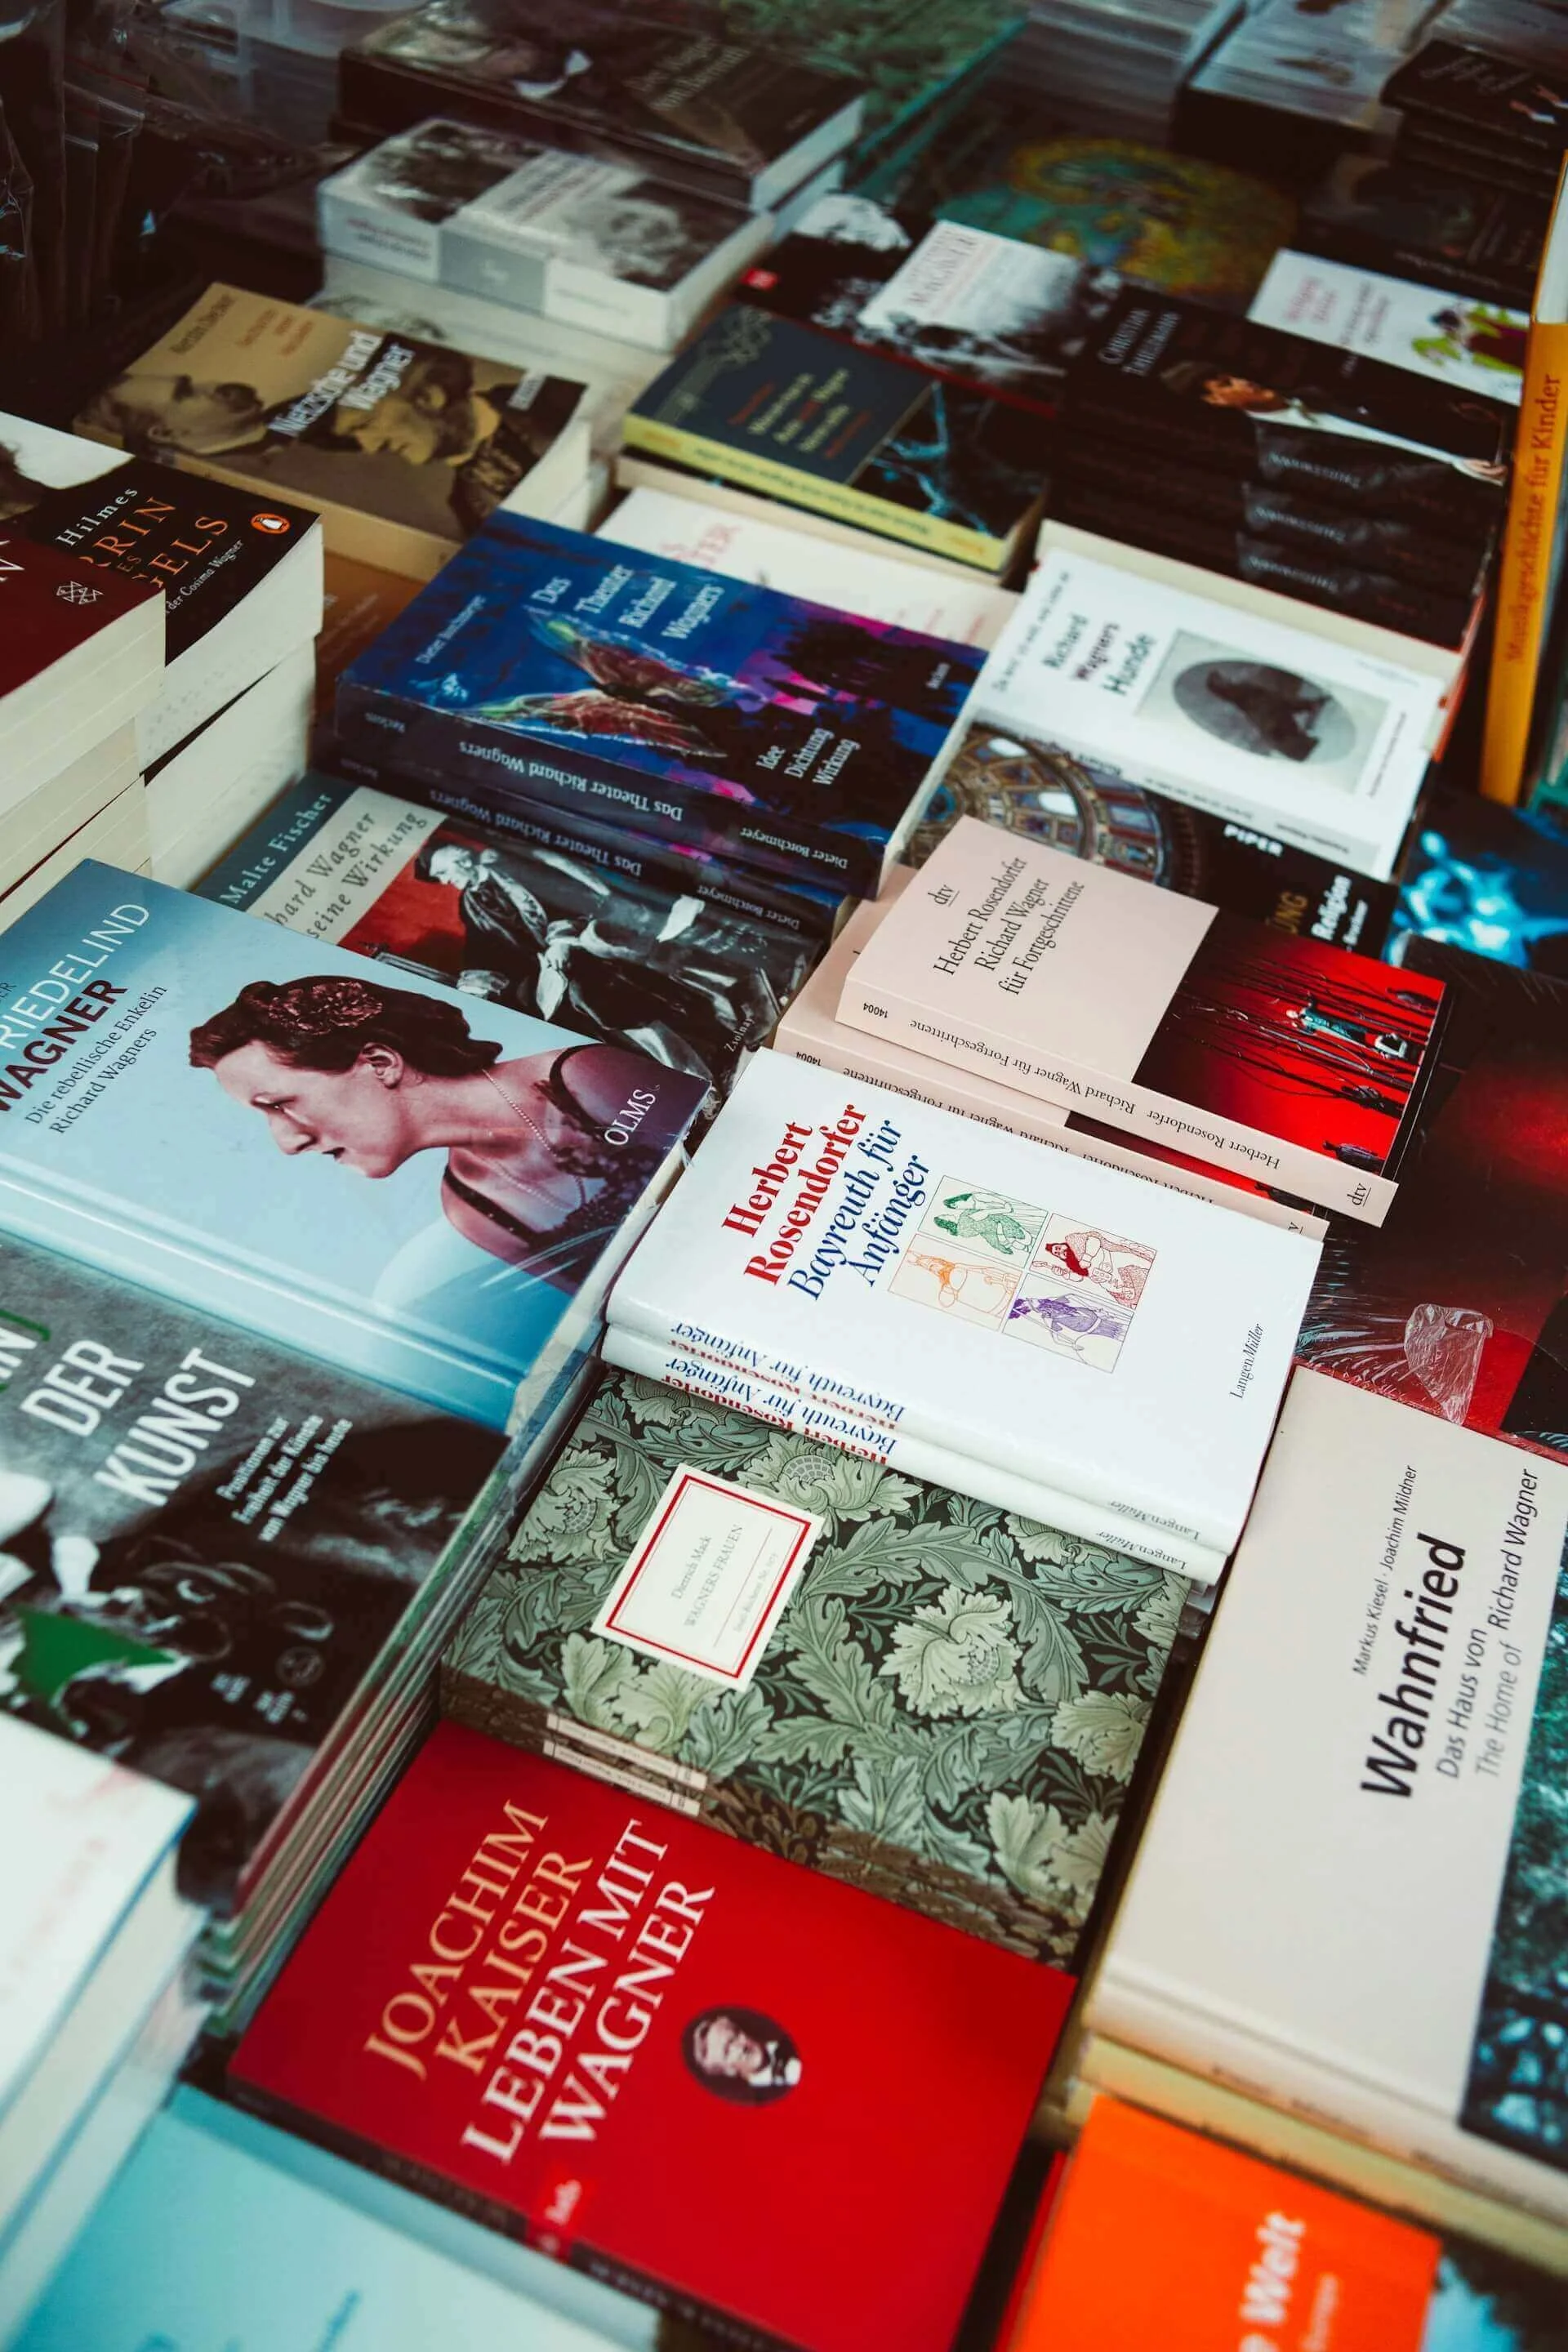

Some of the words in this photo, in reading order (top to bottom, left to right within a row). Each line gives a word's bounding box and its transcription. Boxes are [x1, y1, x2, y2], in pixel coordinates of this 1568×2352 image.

[338, 341, 416, 412] Wagner
[343, 329, 384, 372] und
[1530, 372, 1561, 451] Kinder
[1526, 454, 1551, 497] für
[56, 487, 139, 546] Hilmes
[167, 585, 186, 612] der
[179, 565, 216, 605] Cosima
[209, 539, 246, 574] Wagner
[532, 574, 572, 605] Das
[574, 564, 638, 614] Theater
[1504, 494, 1546, 663] Musikgeschichte
[617, 576, 678, 630] Richard
[661, 581, 726, 641] Wagners
[1041, 612, 1089, 673] Richard
[1071, 621, 1120, 681] Wagners
[1102, 632, 1156, 697] Hunde
[458, 740, 525, 775] Wagners
[527, 760, 590, 796] Richard
[755, 745, 786, 773] Idee
[784, 727, 835, 780] Dichtung
[812, 738, 862, 786] Wirkung
[429, 787, 492, 824] Wagners
[589, 777, 653, 812] Theater
[654, 798, 684, 822] Das
[220, 855, 278, 906] Malte
[269, 791, 334, 855] Fischer
[494, 808, 552, 843] Richard
[553, 829, 613, 864] Theater
[739, 826, 809, 858] Borchmeyer
[1223, 823, 1284, 856] PIPER
[263, 880, 318, 929] hard
[305, 809, 378, 879] Wagner
[305, 892, 352, 941] seine
[338, 809, 430, 889] Wirkung
[614, 851, 644, 876] Das
[811, 846, 849, 869] Dieter
[697, 884, 761, 919] Borchmeyer
[761, 905, 801, 932] Dieter
[931, 882, 956, 907] dtv
[933, 905, 987, 977] Herbert
[975, 855, 1029, 924] Rosendorfer
[1311, 875, 1352, 941] Religion
[974, 906, 1023, 973] Richard
[1012, 876, 1052, 927] Wagner
[998, 959, 1029, 996] für
[1018, 880, 1086, 978] Fortgeschrittene
[0, 903, 151, 1049] RIEDELIND
[723, 1013, 755, 1054] Zsolnay
[862, 1000, 889, 1020] 14004
[0, 978, 128, 1113] WAGNER
[24, 1094, 55, 1125] Die
[49, 1026, 122, 1104] rebellische
[114, 985, 169, 1040] Enkelin
[909, 1017, 1012, 1069] Fortgeschrittene
[1009, 1056, 1032, 1078] für
[49, 1076, 106, 1135] Richard
[100, 1026, 158, 1085] Wagners
[1031, 1067, 1085, 1097] Wagner
[1084, 1083, 1137, 1116] Richard
[604, 1088, 657, 1147] OLMS
[1145, 1107, 1227, 1148] Rosendorfer
[721, 1120, 814, 1239] Herbert
[1227, 1136, 1282, 1171] Herbert
[742, 1102, 869, 1287] Rosendorfer
[786, 1169, 881, 1301] Bayreuth
[853, 1118, 903, 1173] für
[847, 1154, 932, 1288] Anfänger
[1344, 1182, 1368, 1206] dtv
[670, 1321, 768, 1369] Anfänger
[767, 1359, 809, 1384] für
[20, 1339, 145, 1437] DER
[664, 1356, 764, 1405] Anfänger
[762, 1394, 802, 1421] für
[808, 1371, 908, 1425] Bayreuth
[93, 1347, 256, 1508] KUNST
[801, 1406, 899, 1458] Bayreuth
[269, 1472, 315, 1517] Wagner
[1394, 1464, 1418, 1521] Mildner
[1504, 1468, 1540, 1556] Wagner
[693, 1535, 713, 1561] Mack
[1382, 1520, 1405, 1572] Joachim
[684, 1569, 724, 1628] WAGNERS
[712, 1524, 744, 1576] FRAUEN
[1365, 1578, 1388, 1621] Kiesel
[1486, 1548, 1525, 1632] Richard
[1352, 1621, 1380, 1677] Markus
[1359, 1530, 1468, 1800] Wahnfried
[1466, 1627, 1489, 1667] von
[1501, 1640, 1524, 1670] of
[1448, 1672, 1480, 1732] Haus
[1484, 1668, 1518, 1733] Home
[1436, 1724, 1468, 1780] Das
[1474, 1727, 1503, 1780] The
[364, 1798, 550, 2081] JOACHIM
[434, 1850, 595, 2075] KAISER
[460, 1939, 609, 2166] LEBEN
[576, 1818, 670, 1941] MIT
[537, 1880, 716, 2141] WAGNER
[1239, 2211, 1307, 2326] Welt
